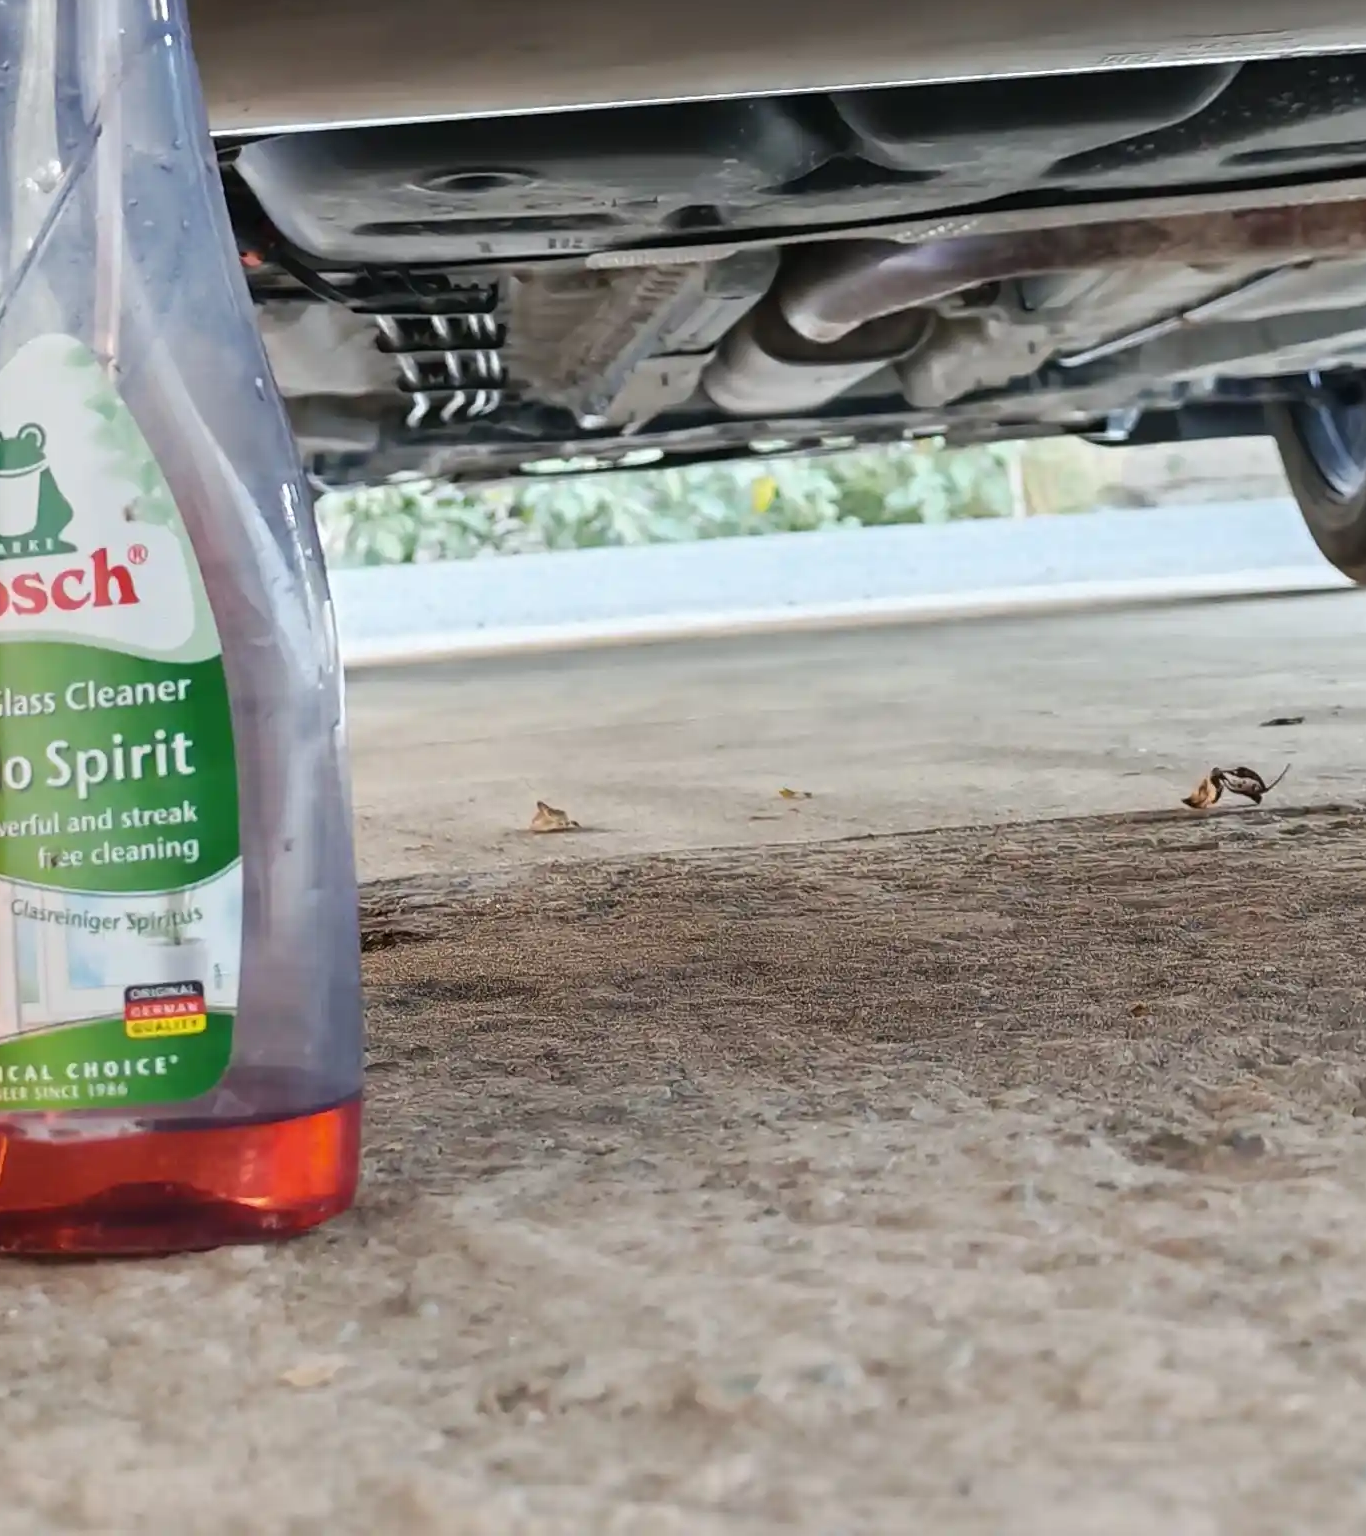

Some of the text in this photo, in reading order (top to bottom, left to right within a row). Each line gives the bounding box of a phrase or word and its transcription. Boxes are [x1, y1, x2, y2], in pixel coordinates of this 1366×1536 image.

[65, 678, 192, 711] Cleaner
[45, 729, 196, 800] Spirit
[66, 807, 113, 833] and
[120, 800, 199, 829] streak
[91, 837, 200, 867] cleaning
[11, 898, 203, 935] Glasreiniger Spiritus
[130, 1003, 198, 1018] GERMAN
